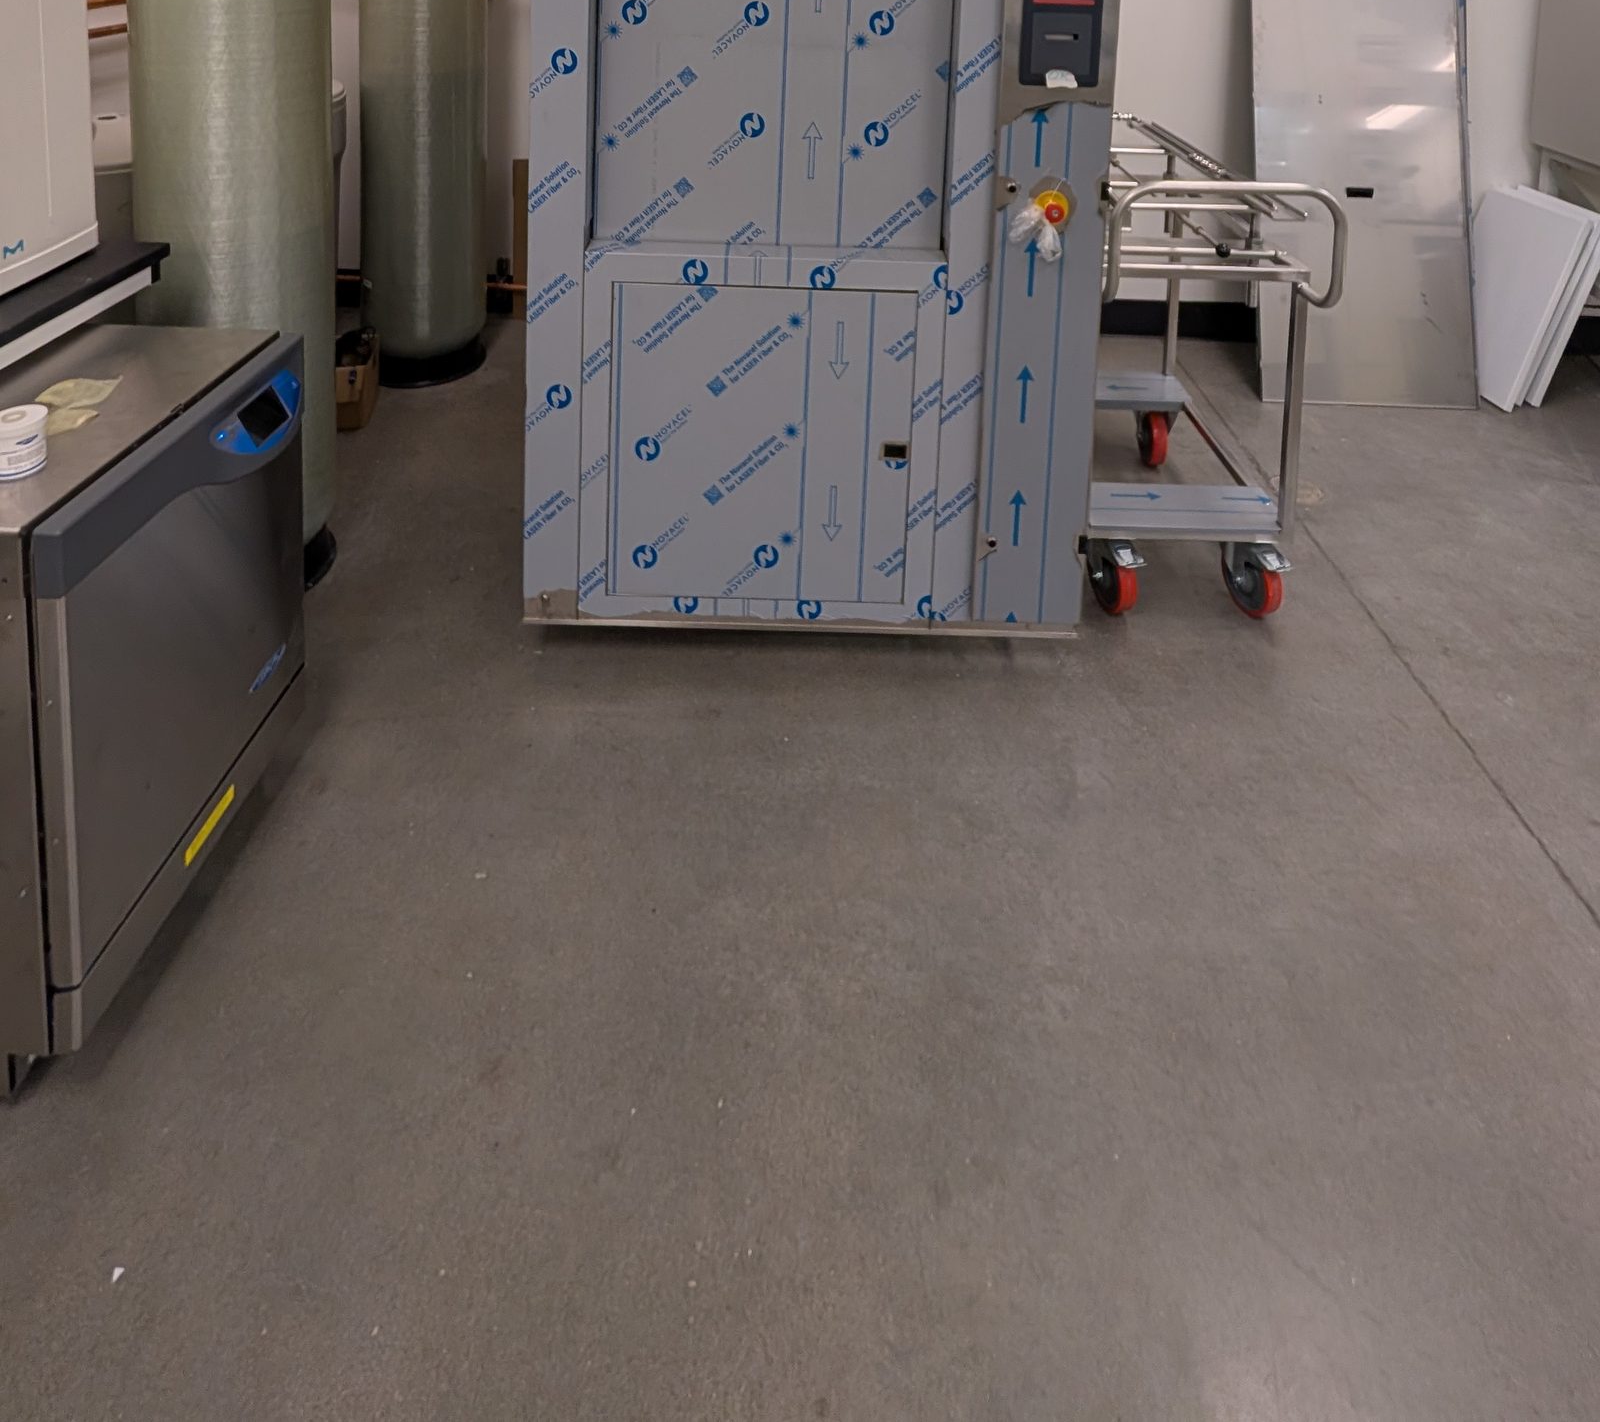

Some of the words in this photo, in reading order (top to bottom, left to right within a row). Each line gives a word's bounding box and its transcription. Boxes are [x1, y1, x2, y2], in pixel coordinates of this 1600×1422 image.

[712, 23, 749, 55] NOVACEL
[963, 57, 979, 72] Fiber
[665, 79, 675, 89] for
[646, 87, 666, 106] LASER
[670, 88, 682, 98] The
[632, 104, 648, 118] Fiber
[884, 93, 922, 125] NOVACEL
[625, 116, 649, 138] Solution
[708, 134, 746, 166] NOVACEL
[544, 161, 569, 183] Solution
[546, 182, 562, 197] Fiber
[642, 198, 663, 216] LASER
[666, 198, 678, 209] The
[910, 209, 922, 218] The
